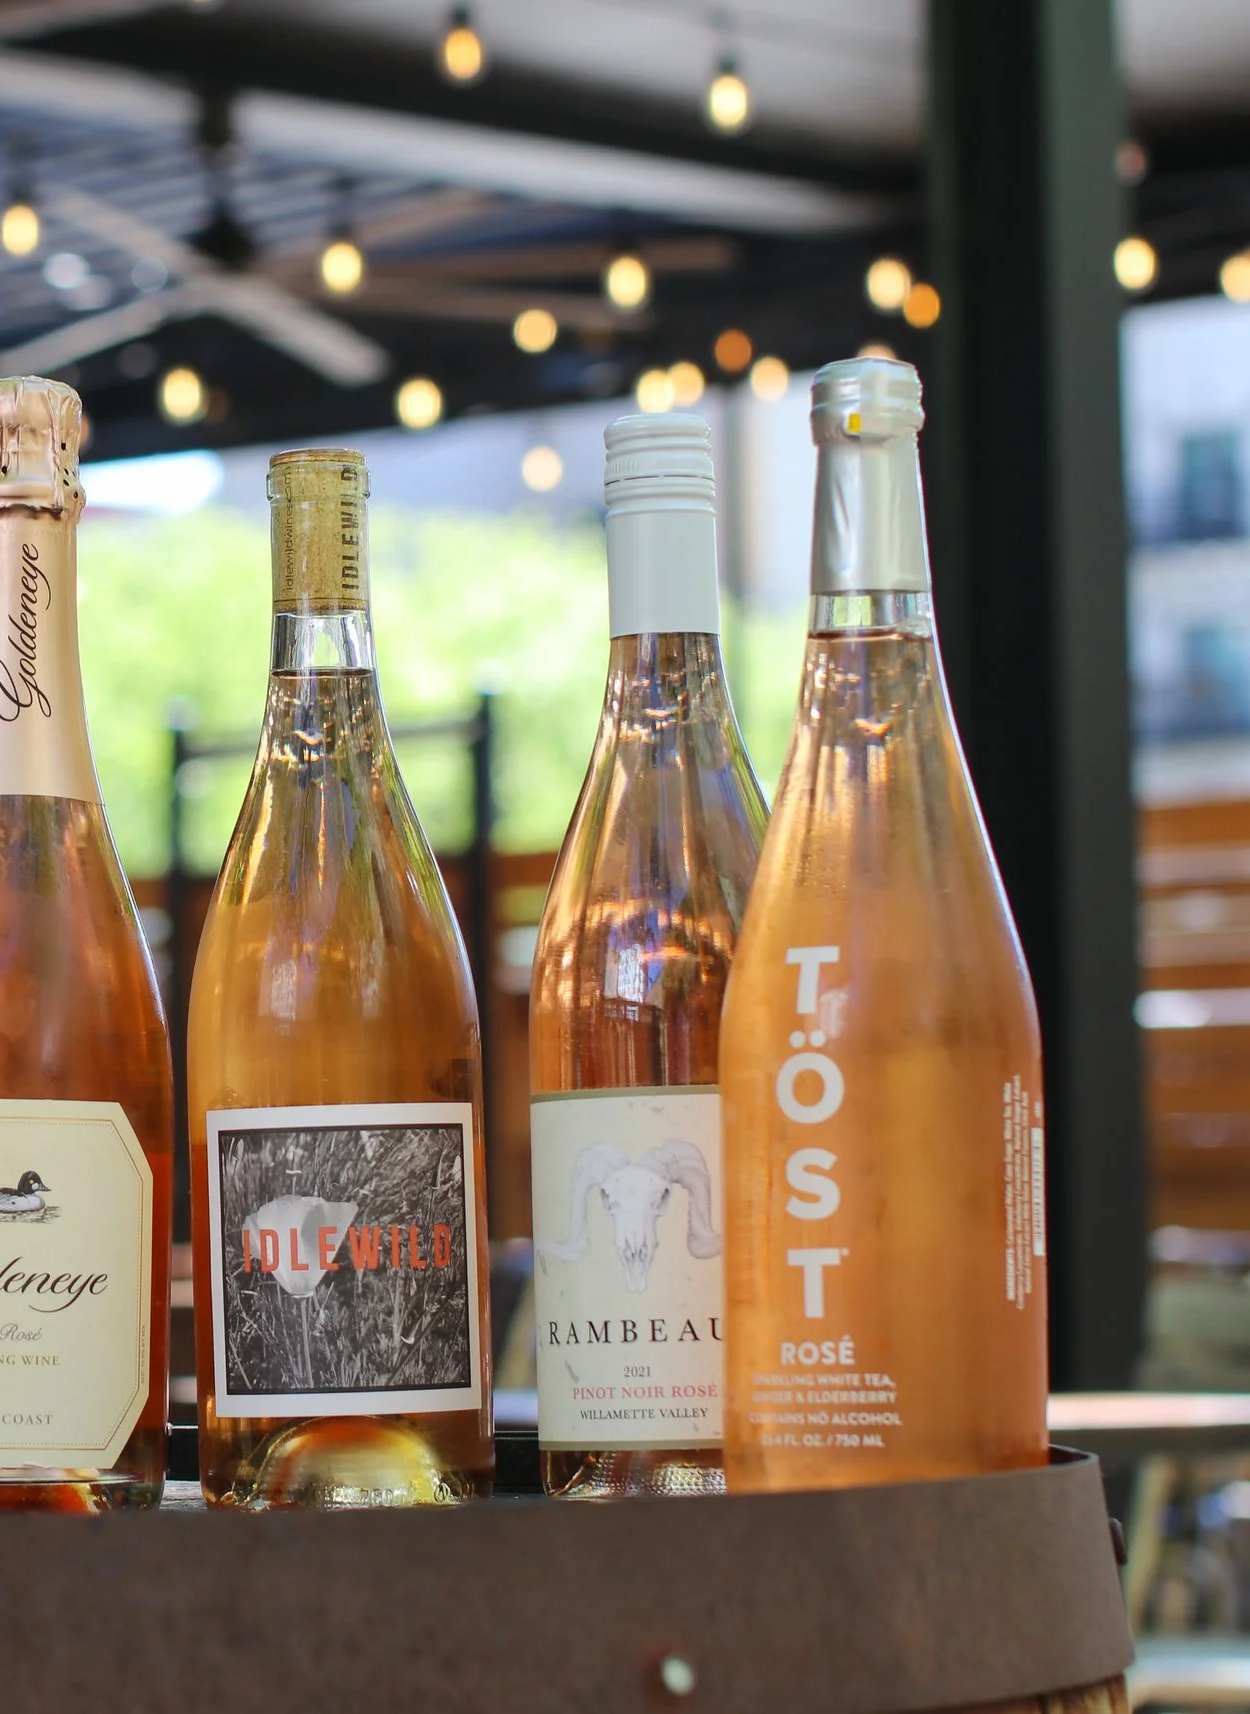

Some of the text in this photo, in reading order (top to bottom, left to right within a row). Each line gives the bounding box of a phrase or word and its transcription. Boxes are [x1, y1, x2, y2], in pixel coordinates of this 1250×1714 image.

[775, 945, 845, 1318] TÖST
[243, 1223, 451, 1274] IDLEWILD
[0, 1323, 43, 1341] Rosé
[549, 1318, 725, 1345] RAMBEAU
[780, 1334, 855, 1365] ROSÉ
[21, 1355, 60, 1366] WINE
[624, 1366, 652, 1378] 2021
[816, 1373, 861, 1387] WHITE
[572, 1381, 718, 1400] PINOT NOIR ROSÉ
[806, 1390, 897, 1404] ELDERBERRY
[2, 1413, 54, 1425] COAST
[580, 1407, 709, 1420] WILLAMETTE VALLEY
[831, 1412, 901, 1426] ALCOHOL
